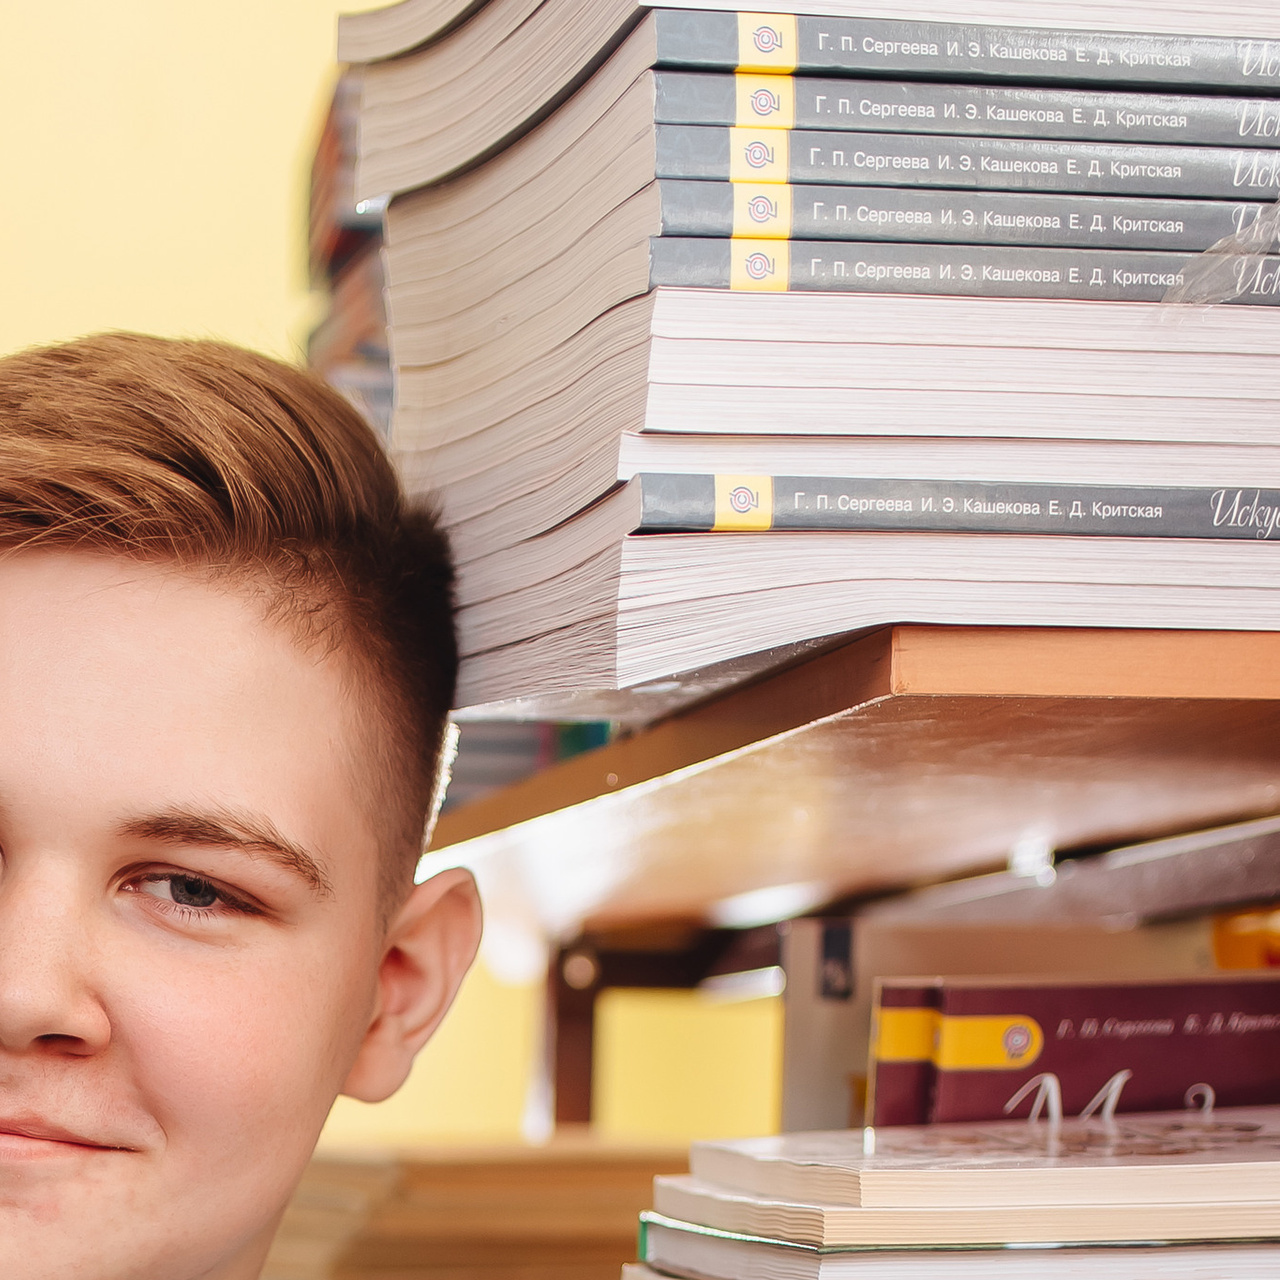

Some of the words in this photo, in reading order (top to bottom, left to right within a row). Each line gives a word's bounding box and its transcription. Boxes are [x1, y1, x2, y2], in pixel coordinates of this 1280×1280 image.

[818, 33, 834, 52] Г.
[840, 37, 858, 53] П.
[861, 37, 939, 57] Сергеева
[946, 42, 964, 58] И.
[967, 42, 986, 59] Э.
[989, 43, 1068, 63] Кашекова
[1074, 47, 1091, 64] Е.
[1096, 48, 1114, 67] Д.
[1119, 50, 1192, 68] Критская
[1238, 40, 1280, 77] Ис
[815, 96, 831, 114] Г.
[837, 99, 855, 115] П.
[858, 99, 936, 119] Сергеева
[943, 104, 961, 120] И.
[964, 104, 983, 121] Э.
[986, 105, 1064, 124] Кашекова
[1070, 108, 1087, 125] Е.
[1092, 109, 1110, 128] Д.
[1115, 111, 1188, 129] Критская
[809, 148, 825, 166] Г.
[831, 151, 849, 167] П.
[852, 151, 930, 171] Сергеева
[937, 156, 955, 171] И.
[958, 155, 977, 172] Э.
[980, 156, 1059, 176] Кашекова
[1065, 160, 1082, 176] Е.
[1087, 160, 1105, 179] Д.
[1110, 162, 1183, 180] Критская
[812, 202, 828, 221] Г.
[834, 206, 852, 222] П.
[855, 206, 933, 225] Сергеева
[940, 210, 958, 226] И.
[961, 210, 979, 227] Э.
[982, 211, 1061, 230] Кашекова
[1067, 214, 1084, 231] Е.
[1089, 215, 1107, 234] Д.
[1112, 217, 1185, 234] Критская
[810, 258, 826, 277] Г.
[832, 262, 850, 278] П.
[853, 262, 931, 281] Сергеева
[938, 265, 957, 281] И.
[960, 265, 979, 282] Э.
[982, 266, 1061, 285] Кашекова
[1067, 268, 1084, 285] Е.
[1089, 269, 1107, 288] Д.
[1112, 271, 1185, 288] Критская
[793, 492, 809, 511] Г.
[815, 496, 833, 511] П.
[836, 495, 913, 514] Сергеева
[920, 499, 938, 514] И.
[941, 498, 960, 515] Э.
[963, 499, 1041, 518] Кашекова
[1047, 501, 1064, 518] Е.
[1069, 502, 1087, 521] Д.
[1092, 504, 1164, 520] Критская
